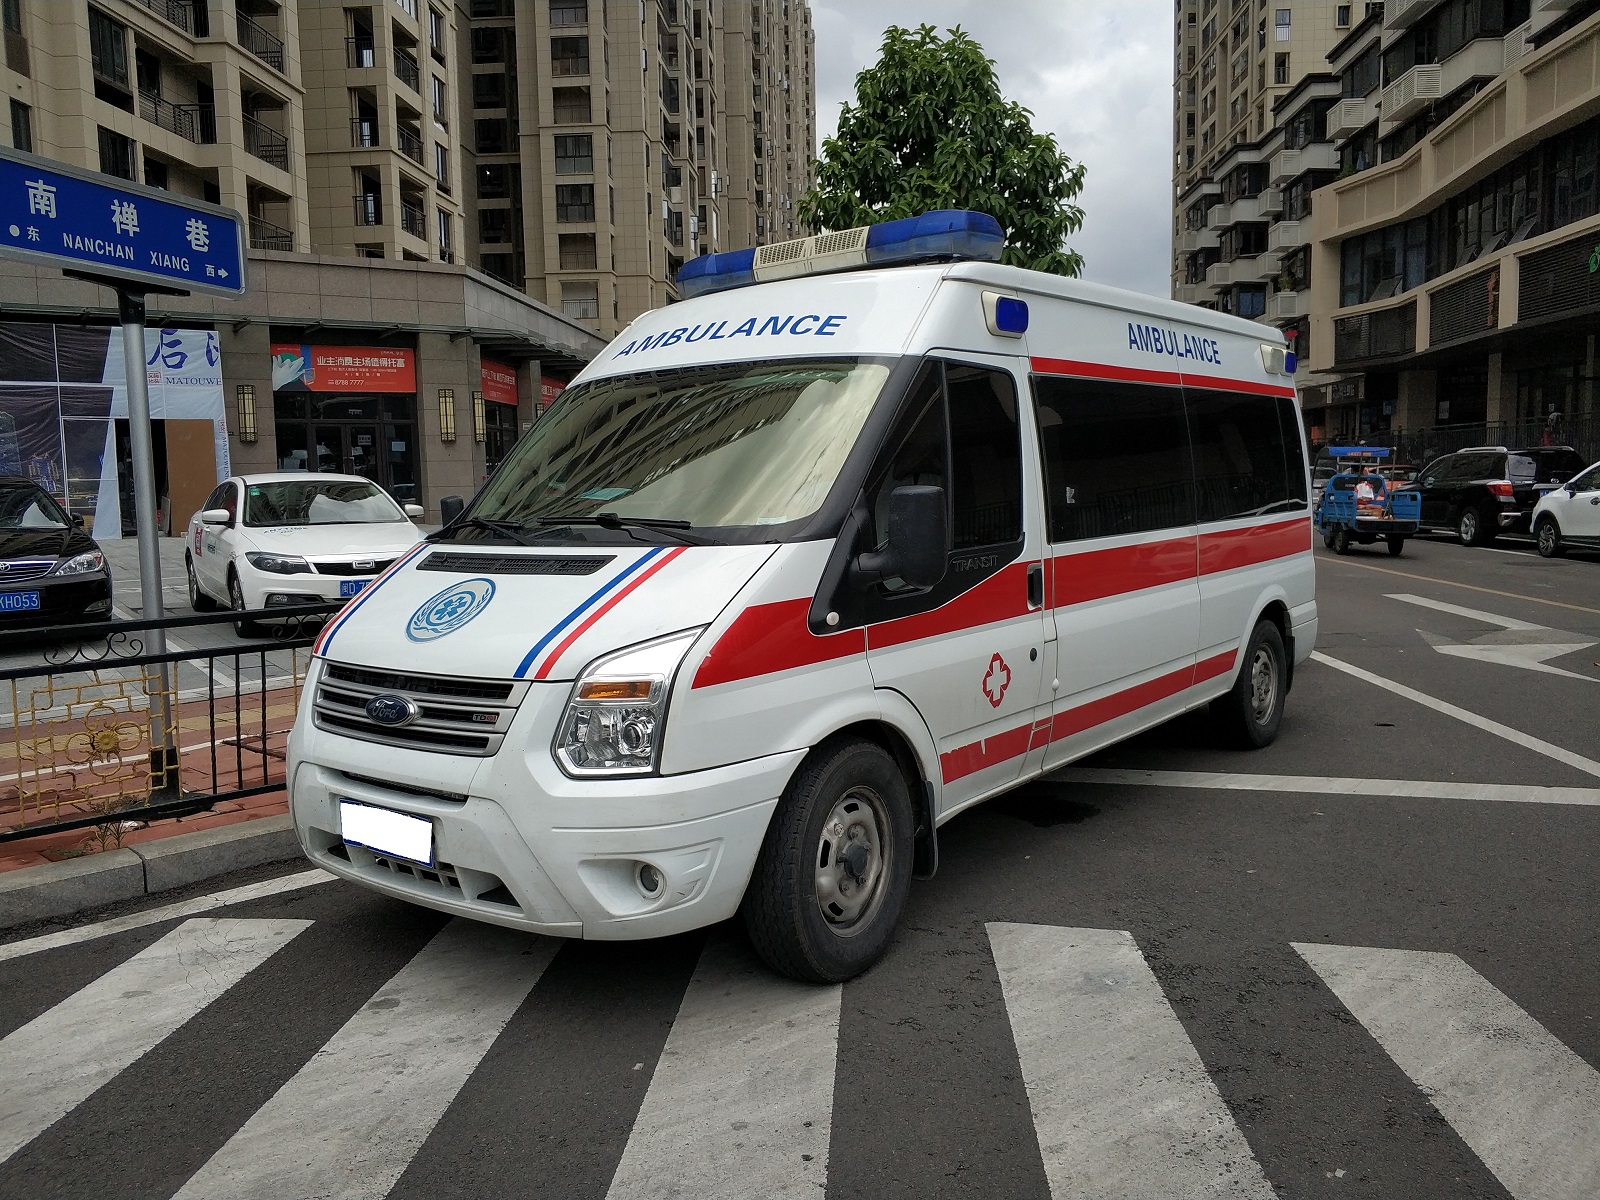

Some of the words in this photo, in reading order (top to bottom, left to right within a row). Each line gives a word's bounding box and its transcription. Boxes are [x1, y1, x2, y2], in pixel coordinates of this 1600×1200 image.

[25, 179, 210, 253] 南禅巷
[27, 225, 41, 242] 东
[63, 232, 135, 261] NANCHAN
[150, 250, 190, 272] XIANG
[204, 264, 216, 278] 西
[611, 314, 848, 361] AMBULANCE
[1128, 322, 1222, 365] AMBULANCE
[952, 554, 999, 572] TRANSIT
[372, 699, 399, 719] Ford
